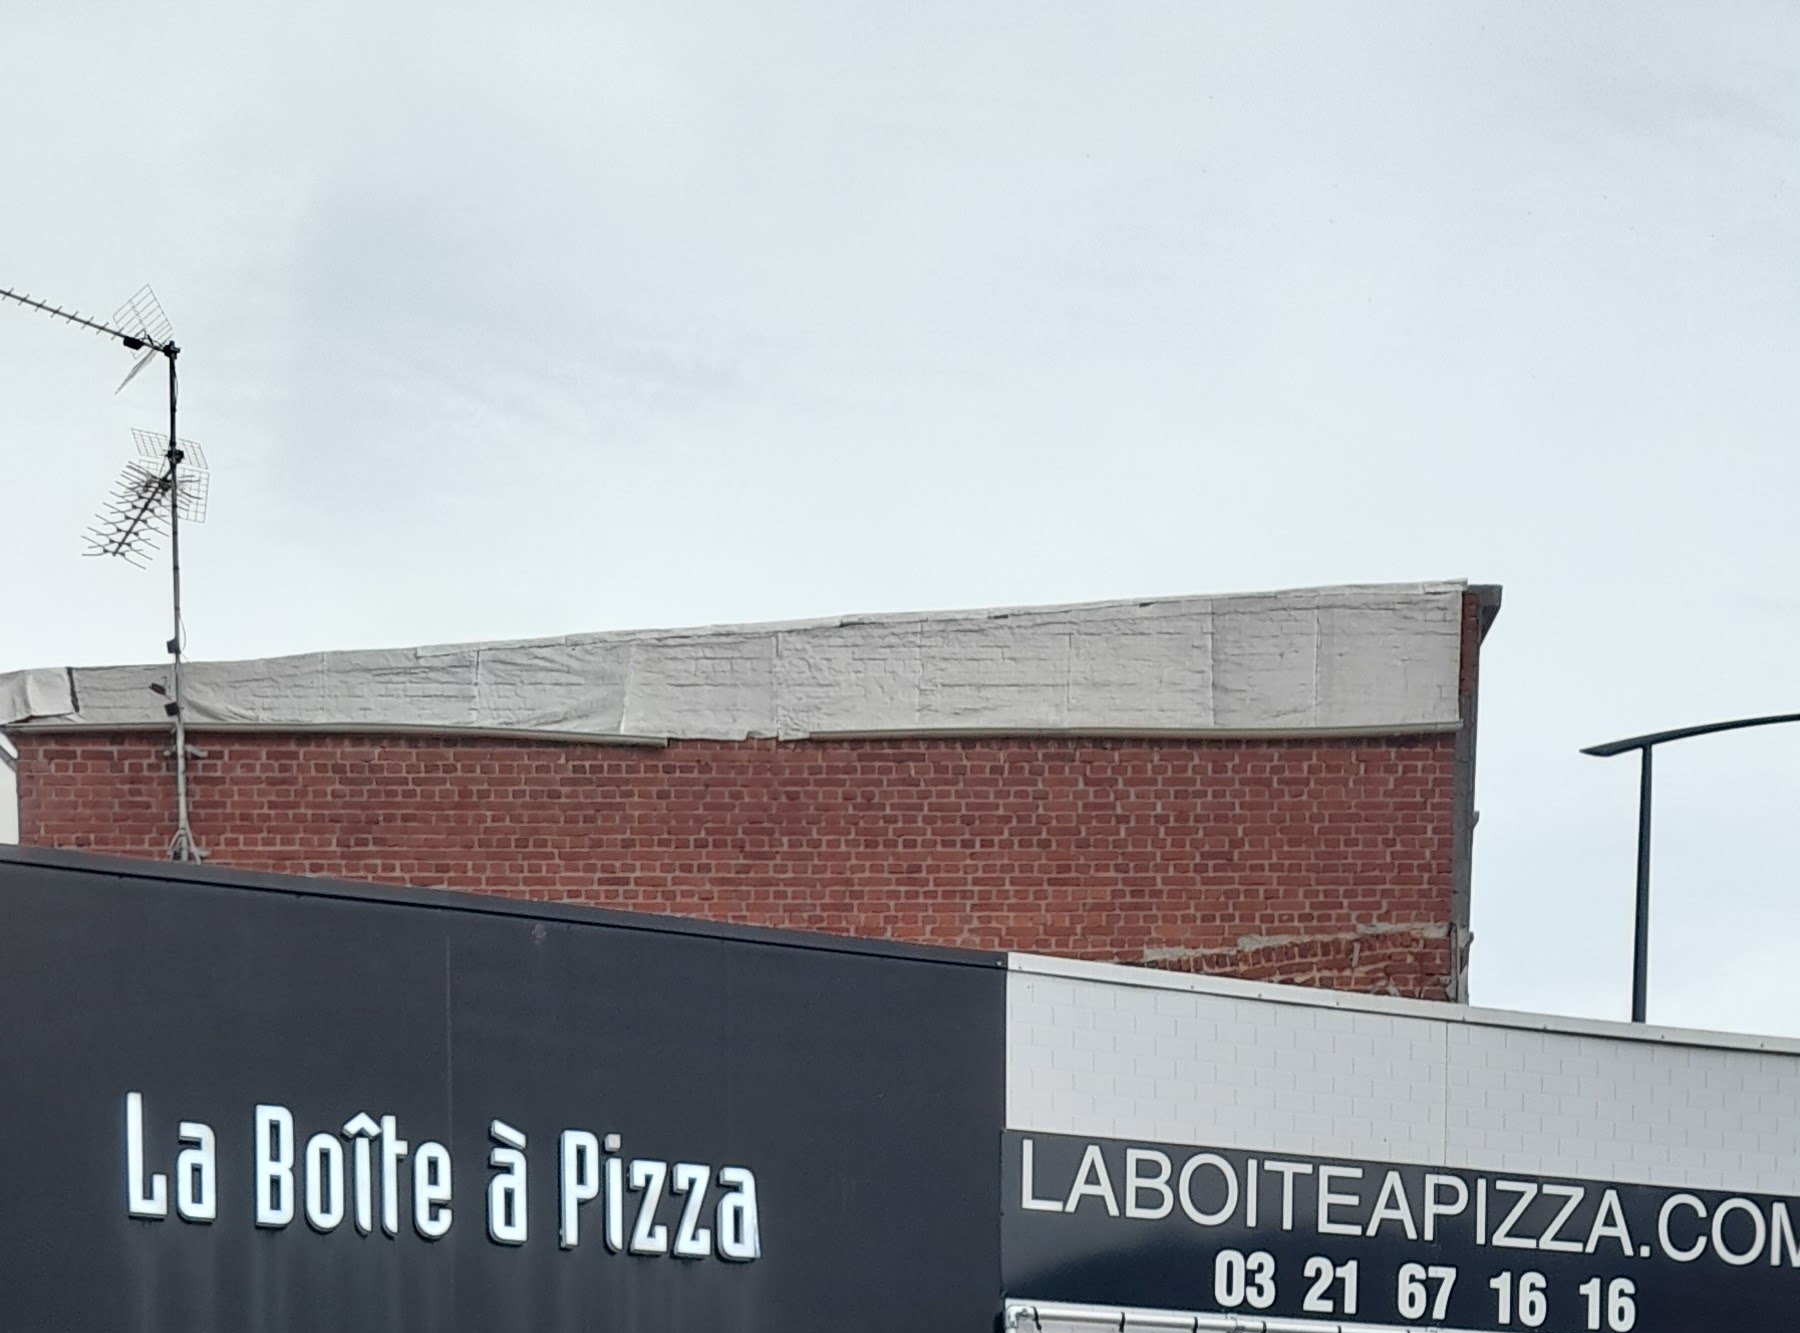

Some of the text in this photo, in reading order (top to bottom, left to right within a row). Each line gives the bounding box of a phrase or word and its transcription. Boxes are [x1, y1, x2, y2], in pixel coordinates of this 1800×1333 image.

[126, 1091, 762, 1262] La Boîte à Pizza
[1021, 1138, 1800, 1268] LABOITEAPIZZA.COM
[1214, 1248, 1637, 1333] 03 21 67 16 16
